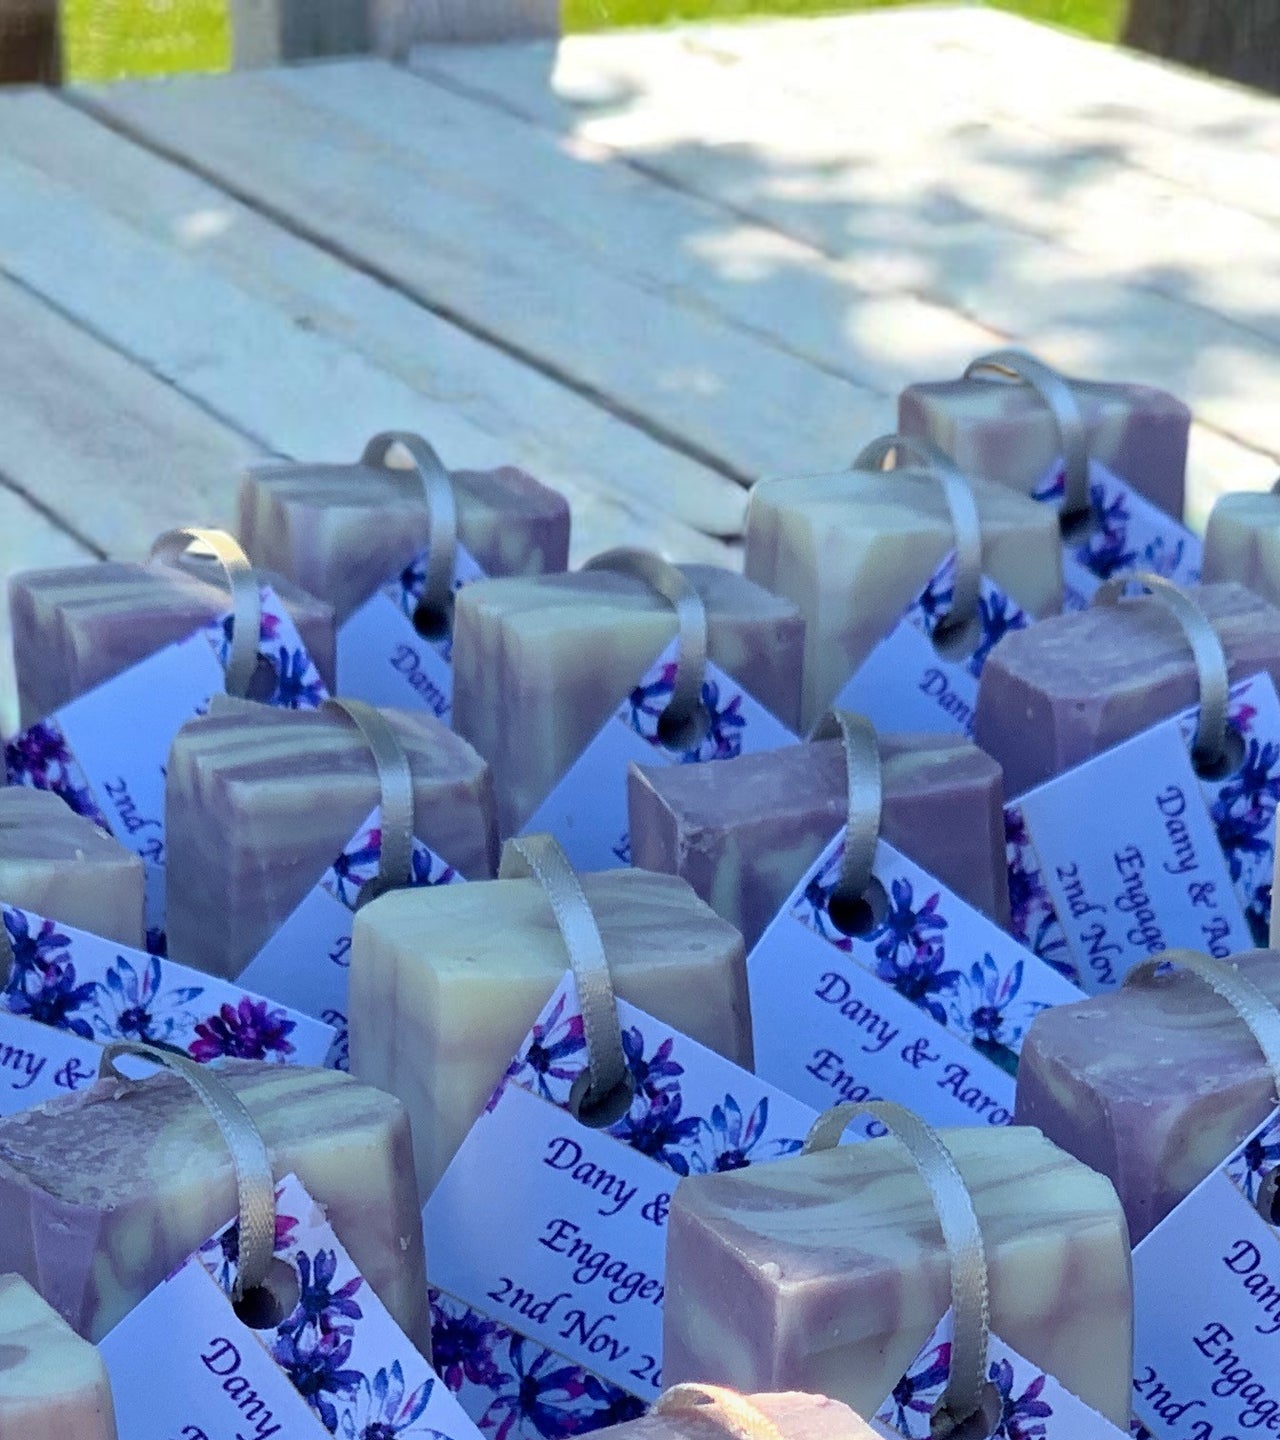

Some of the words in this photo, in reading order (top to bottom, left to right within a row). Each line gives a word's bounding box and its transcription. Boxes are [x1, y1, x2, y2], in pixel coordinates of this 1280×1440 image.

[103, 777, 162, 835] 2nd
[1157, 785, 1198, 874] Dany
[1187, 882, 1218, 908] &
[1057, 863, 1107, 919] 2nd
[1115, 842, 1168, 953] Engage
[1080, 924, 1122, 985] Nov
[54, 1058, 96, 1090] &
[815, 972, 899, 1053] Dany
[901, 1038, 940, 1069] &
[937, 1064, 1014, 1126] Aaro
[544, 1137, 639, 1216] Dany
[539, 1219, 664, 1307] Engage
[487, 1278, 571, 1324] 2nd
[560, 1309, 629, 1361] Nov
[1133, 1366, 1206, 1425] 2nd
